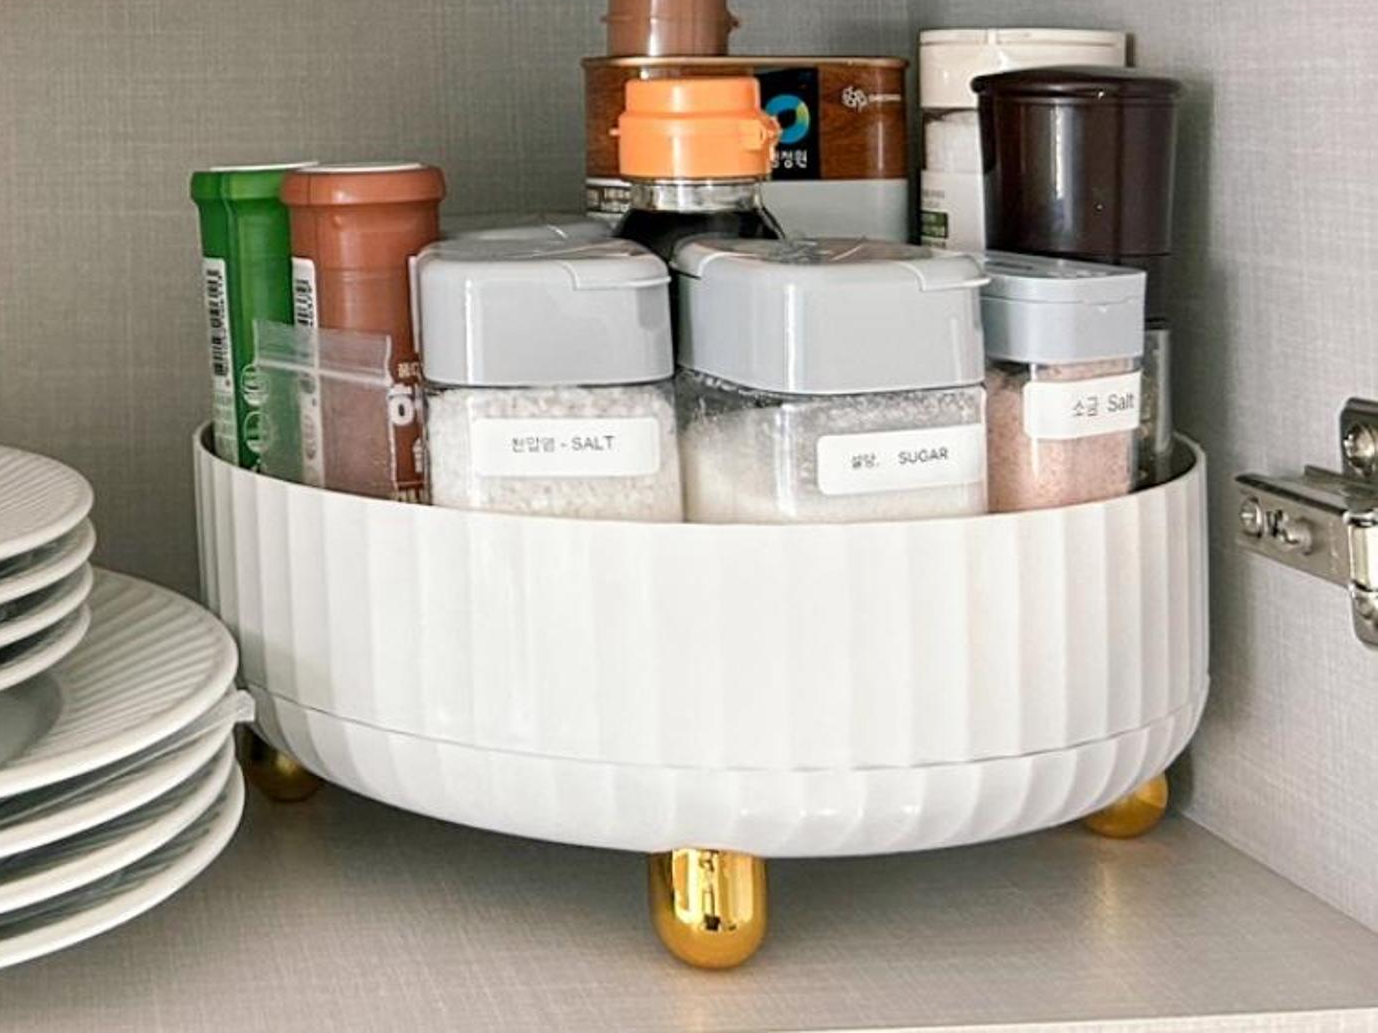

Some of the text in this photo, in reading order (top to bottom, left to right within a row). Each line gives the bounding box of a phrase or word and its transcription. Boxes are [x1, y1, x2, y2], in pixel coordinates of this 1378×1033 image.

[1071, 391, 1135, 417] 소금 Salt
[571, 434, 615, 451] SALT
[898, 447, 948, 465] SUGAR
